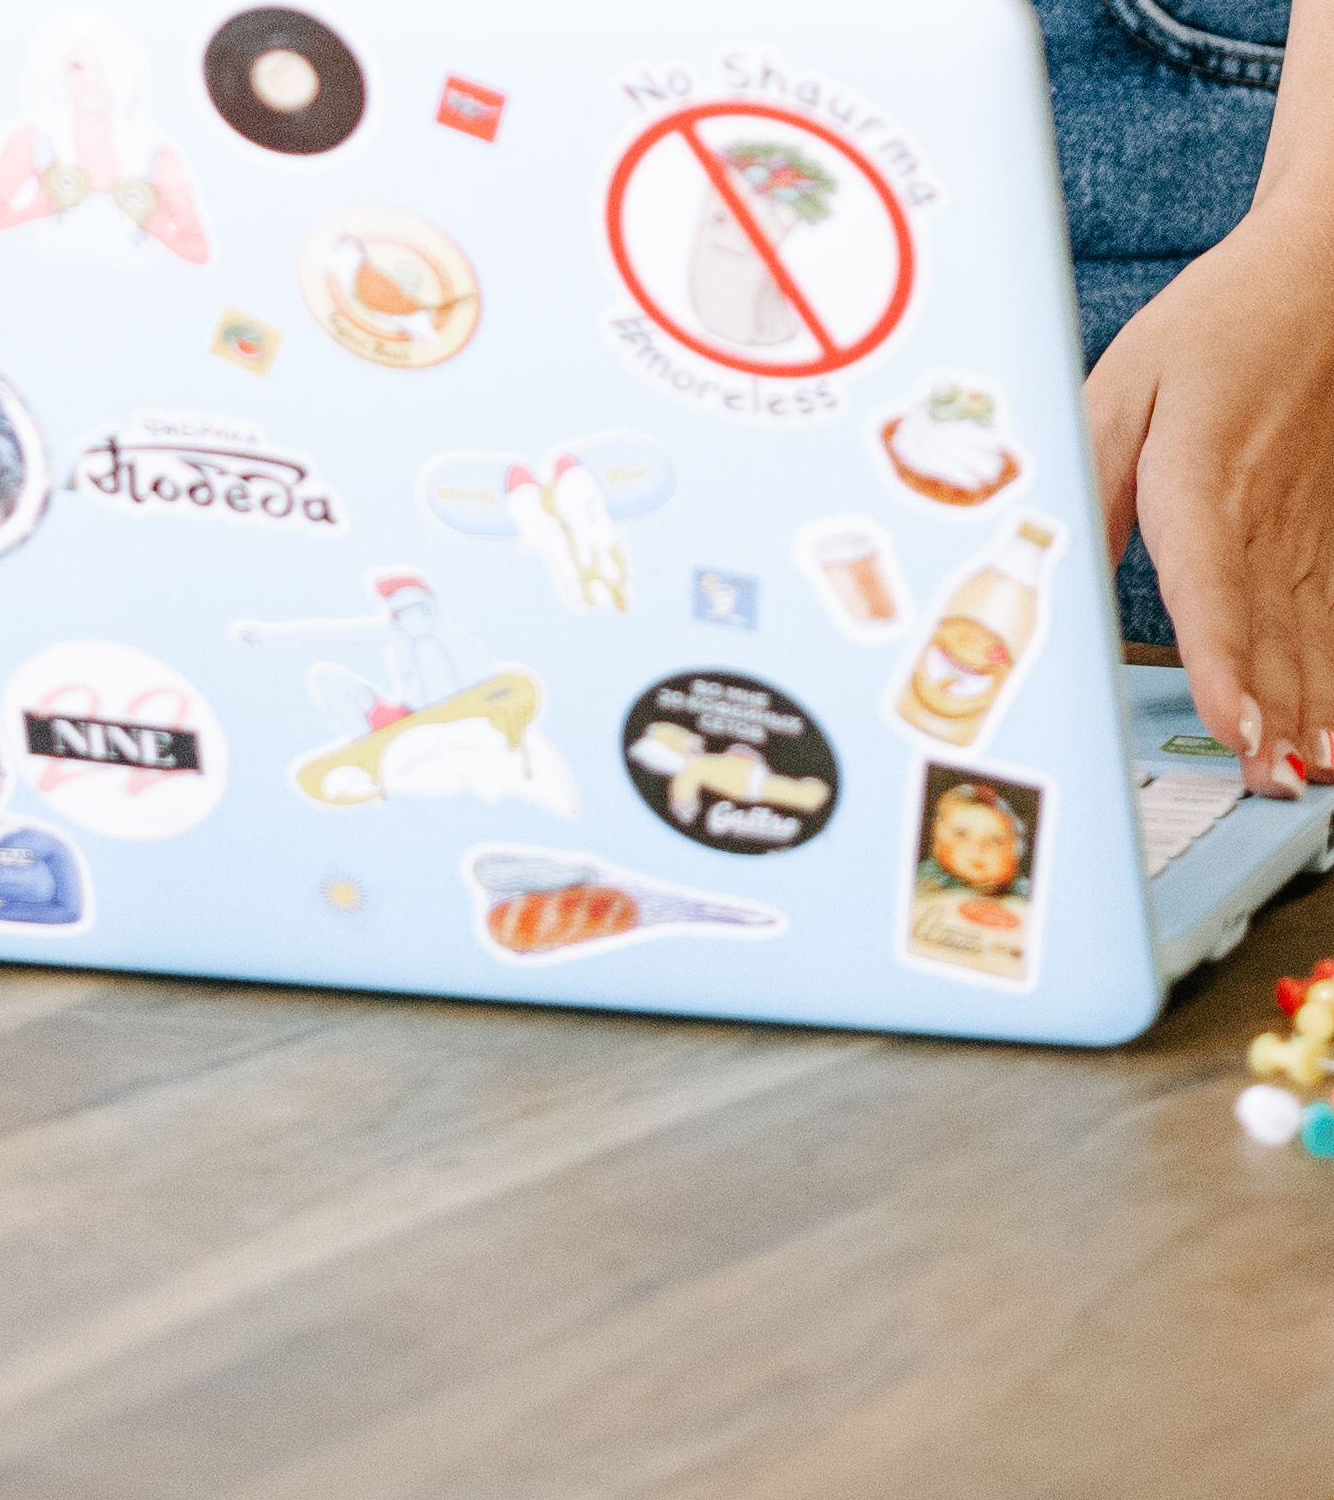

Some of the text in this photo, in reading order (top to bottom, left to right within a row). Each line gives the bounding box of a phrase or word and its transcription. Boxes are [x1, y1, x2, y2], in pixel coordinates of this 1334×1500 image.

[622, 51, 938, 206] No Shaurma
[53, 717, 178, 771] NINE
